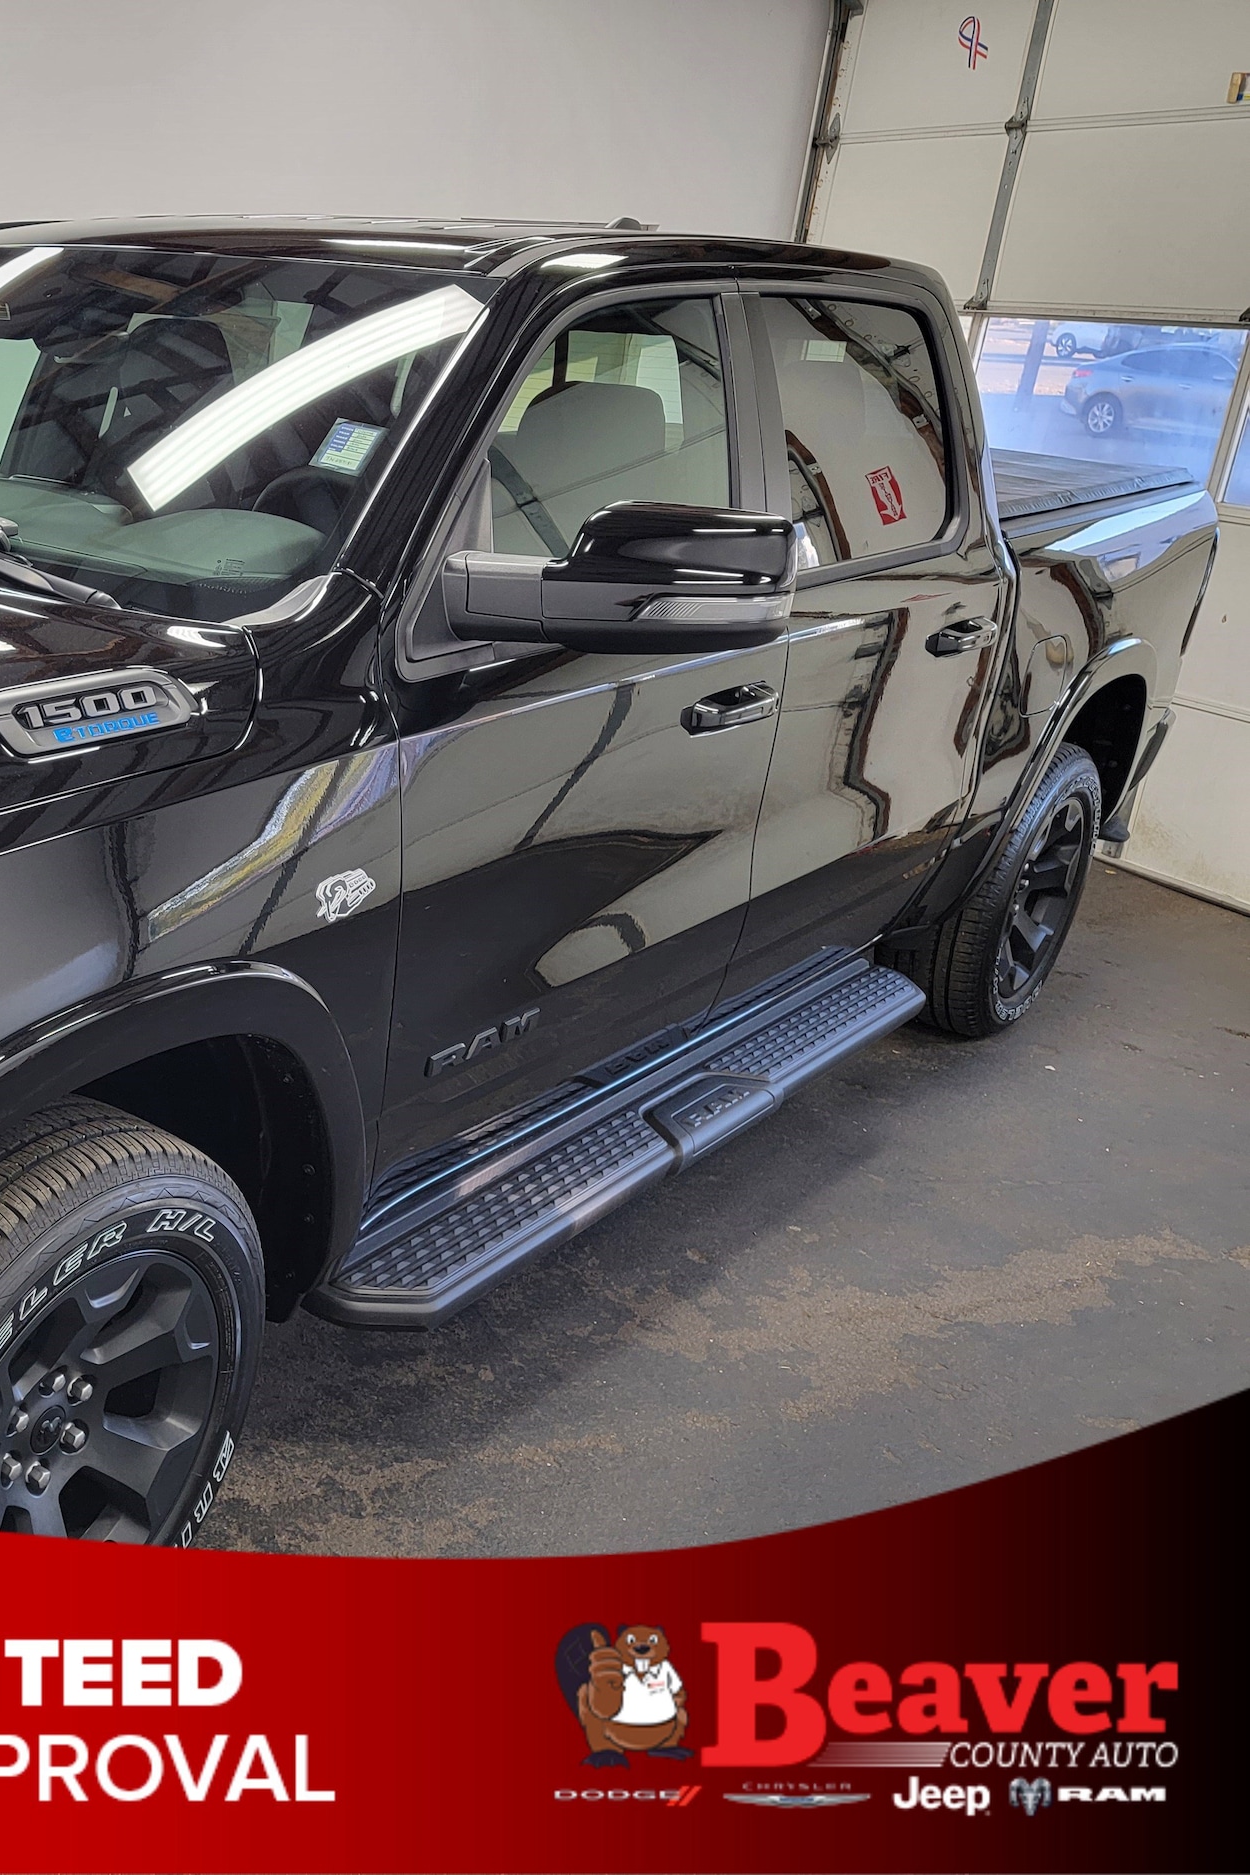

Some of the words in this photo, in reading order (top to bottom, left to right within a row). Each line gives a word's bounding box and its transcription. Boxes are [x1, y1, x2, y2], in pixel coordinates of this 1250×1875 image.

[16, 685, 157, 729] 1500
[423, 1007, 541, 1077] RAM
[146, 1208, 217, 1243] H/L
